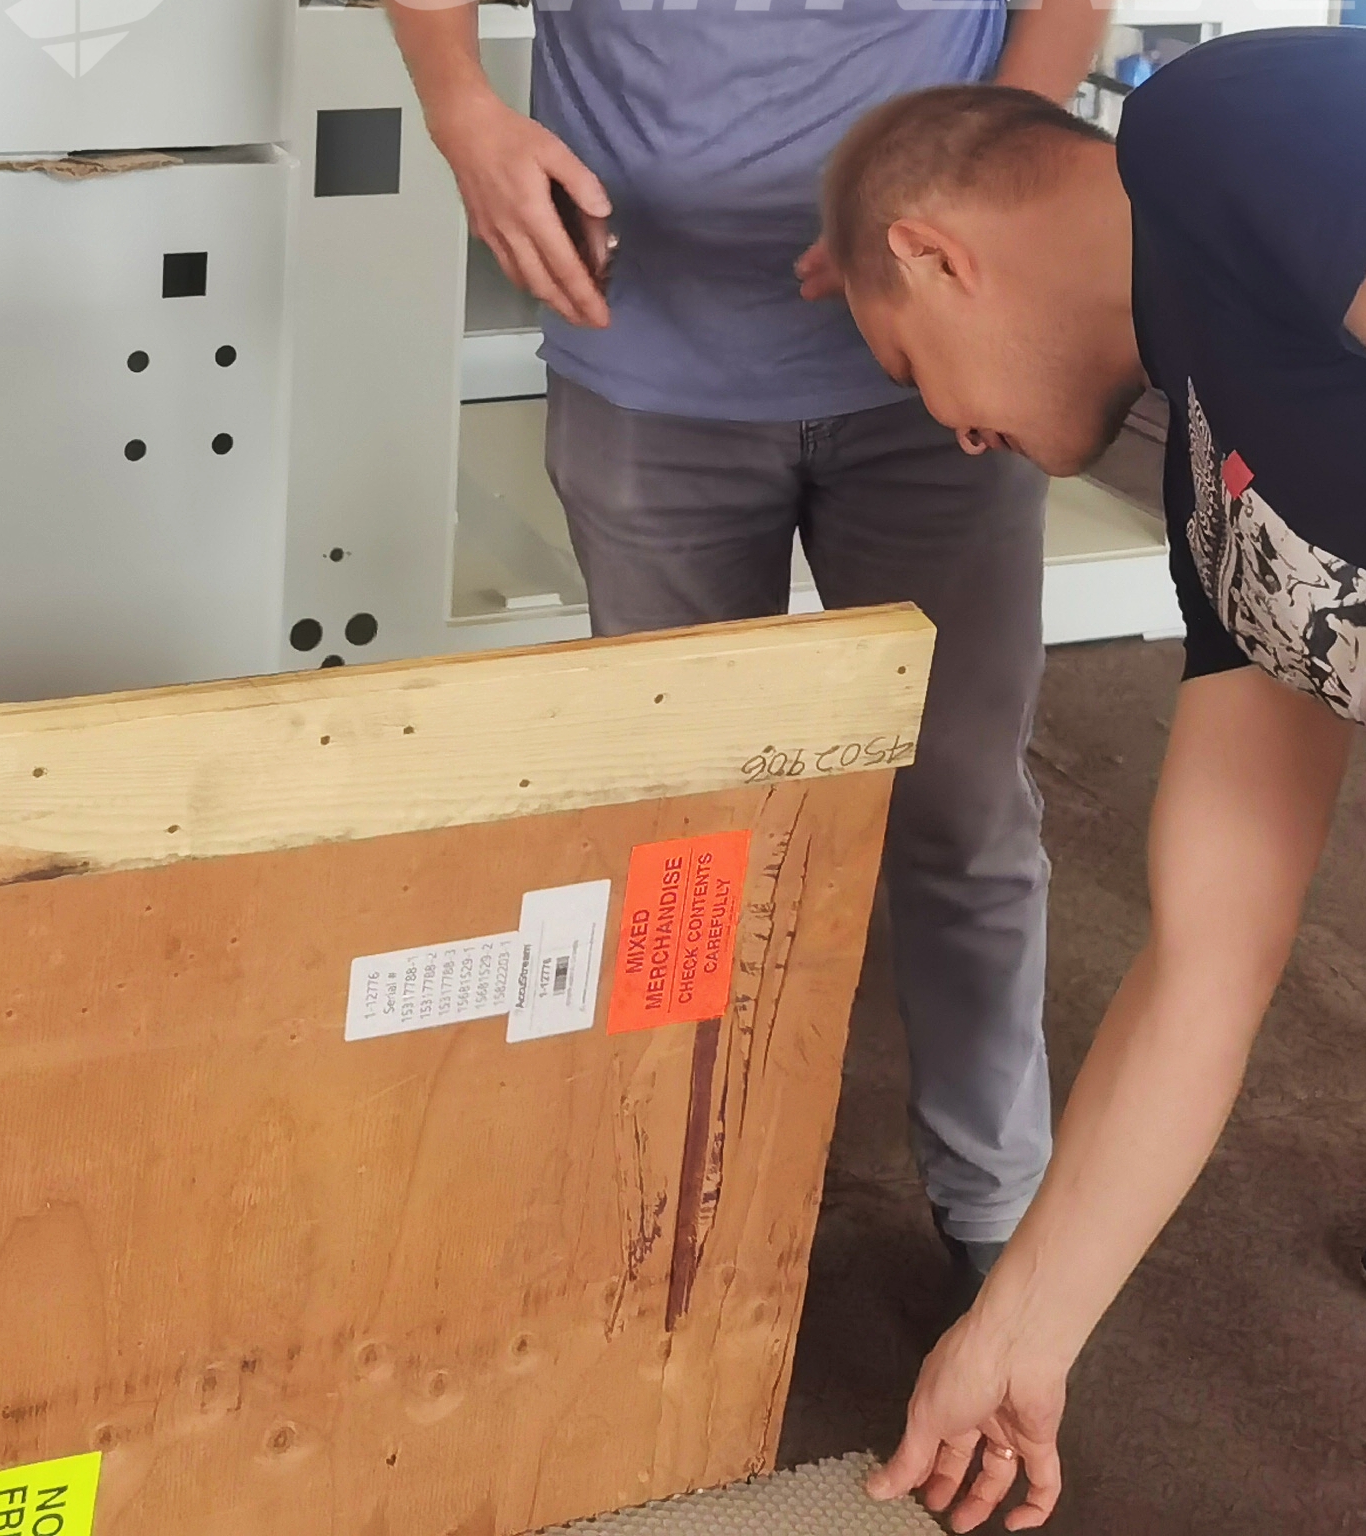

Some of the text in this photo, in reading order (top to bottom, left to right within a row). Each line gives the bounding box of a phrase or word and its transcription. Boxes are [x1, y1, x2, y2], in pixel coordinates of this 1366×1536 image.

[625, 909, 650, 974] MIXED
[645, 856, 683, 1011] MERCHANDISE
[678, 852, 713, 1004] CHECK CONTENTS
[704, 878, 731, 974] CAREFULLY
[383, 982, 397, 1015] Serial
